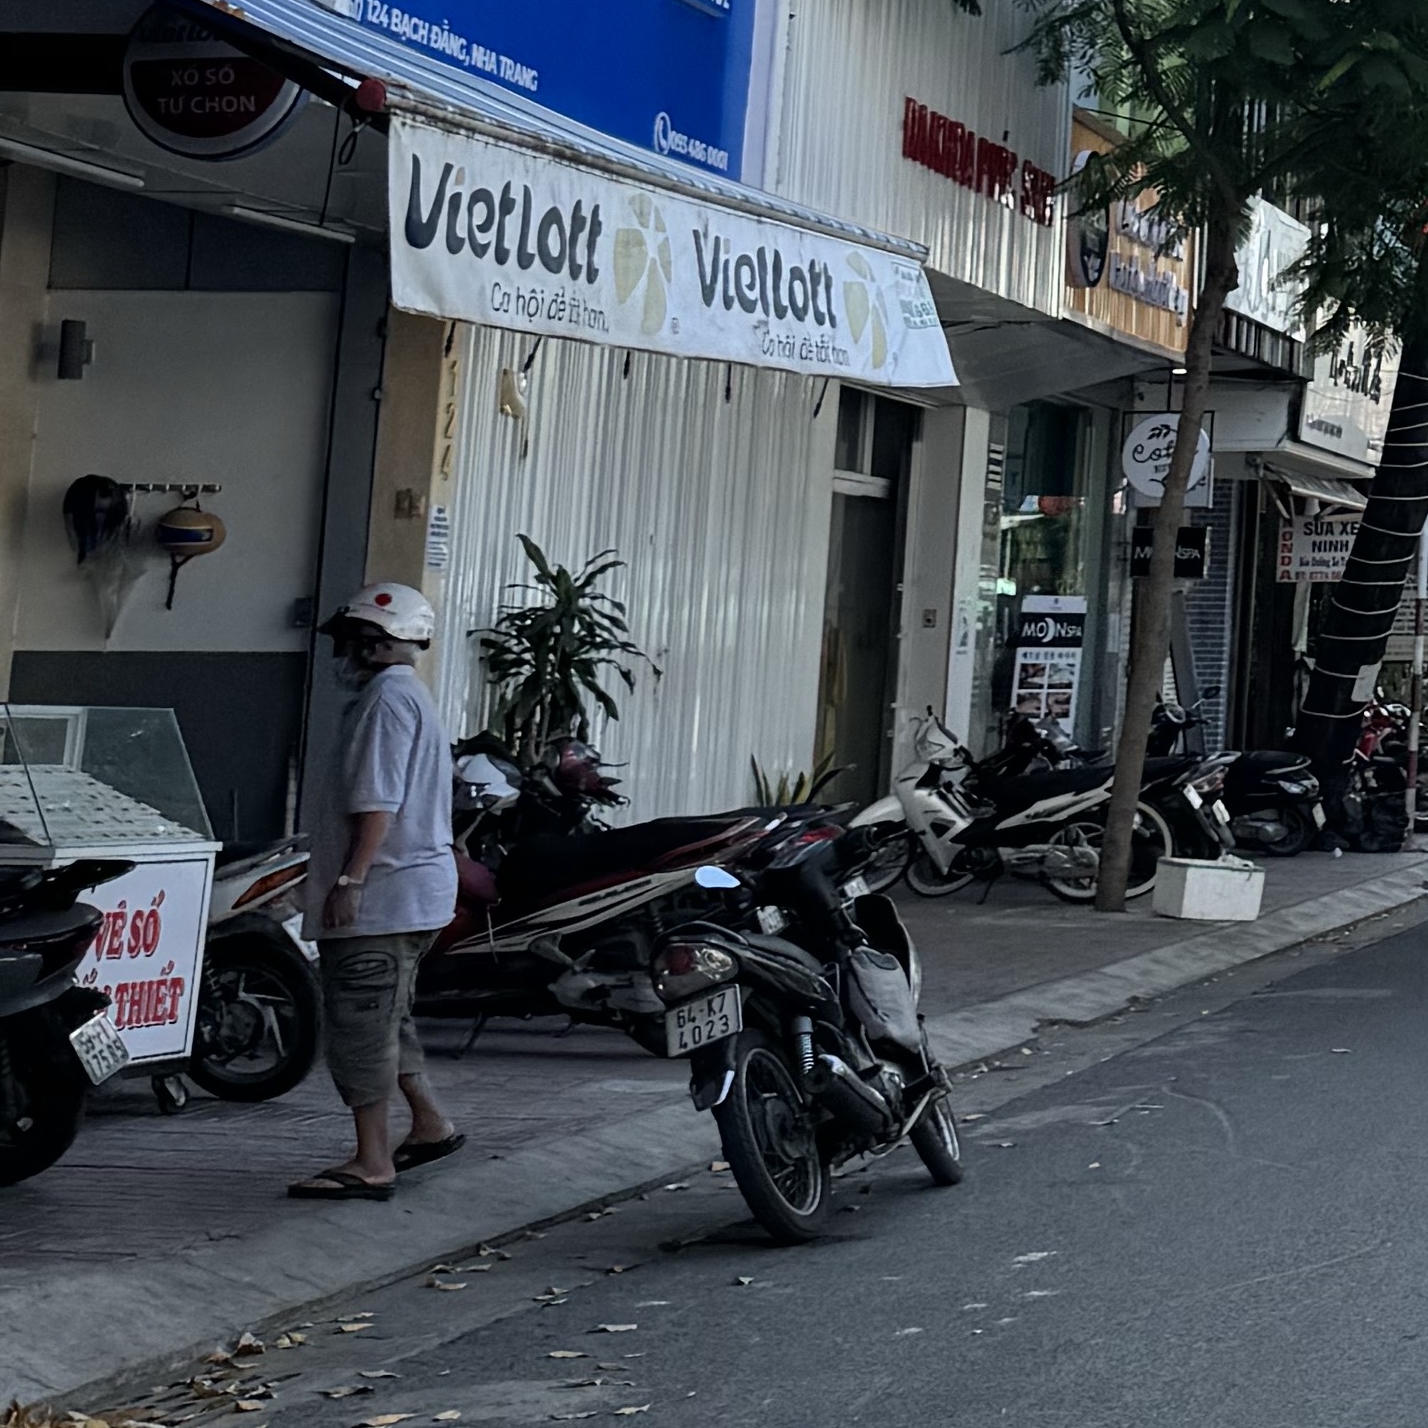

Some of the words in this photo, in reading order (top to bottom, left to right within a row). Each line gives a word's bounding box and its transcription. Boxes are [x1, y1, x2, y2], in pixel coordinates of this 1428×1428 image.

[390, 8, 429, 47] BẠCH
[471, 43, 498, 76] NHA
[499, 54, 539, 92] TRANG
[190, 95, 257, 118] CHỌN
[404, 151, 603, 285] Vietlott
[516, 285, 545, 324] hội
[1312, 539, 1349, 554] NINH
[128, 889, 166, 959] SỐ
[114, 960, 186, 1032] THIẾT
